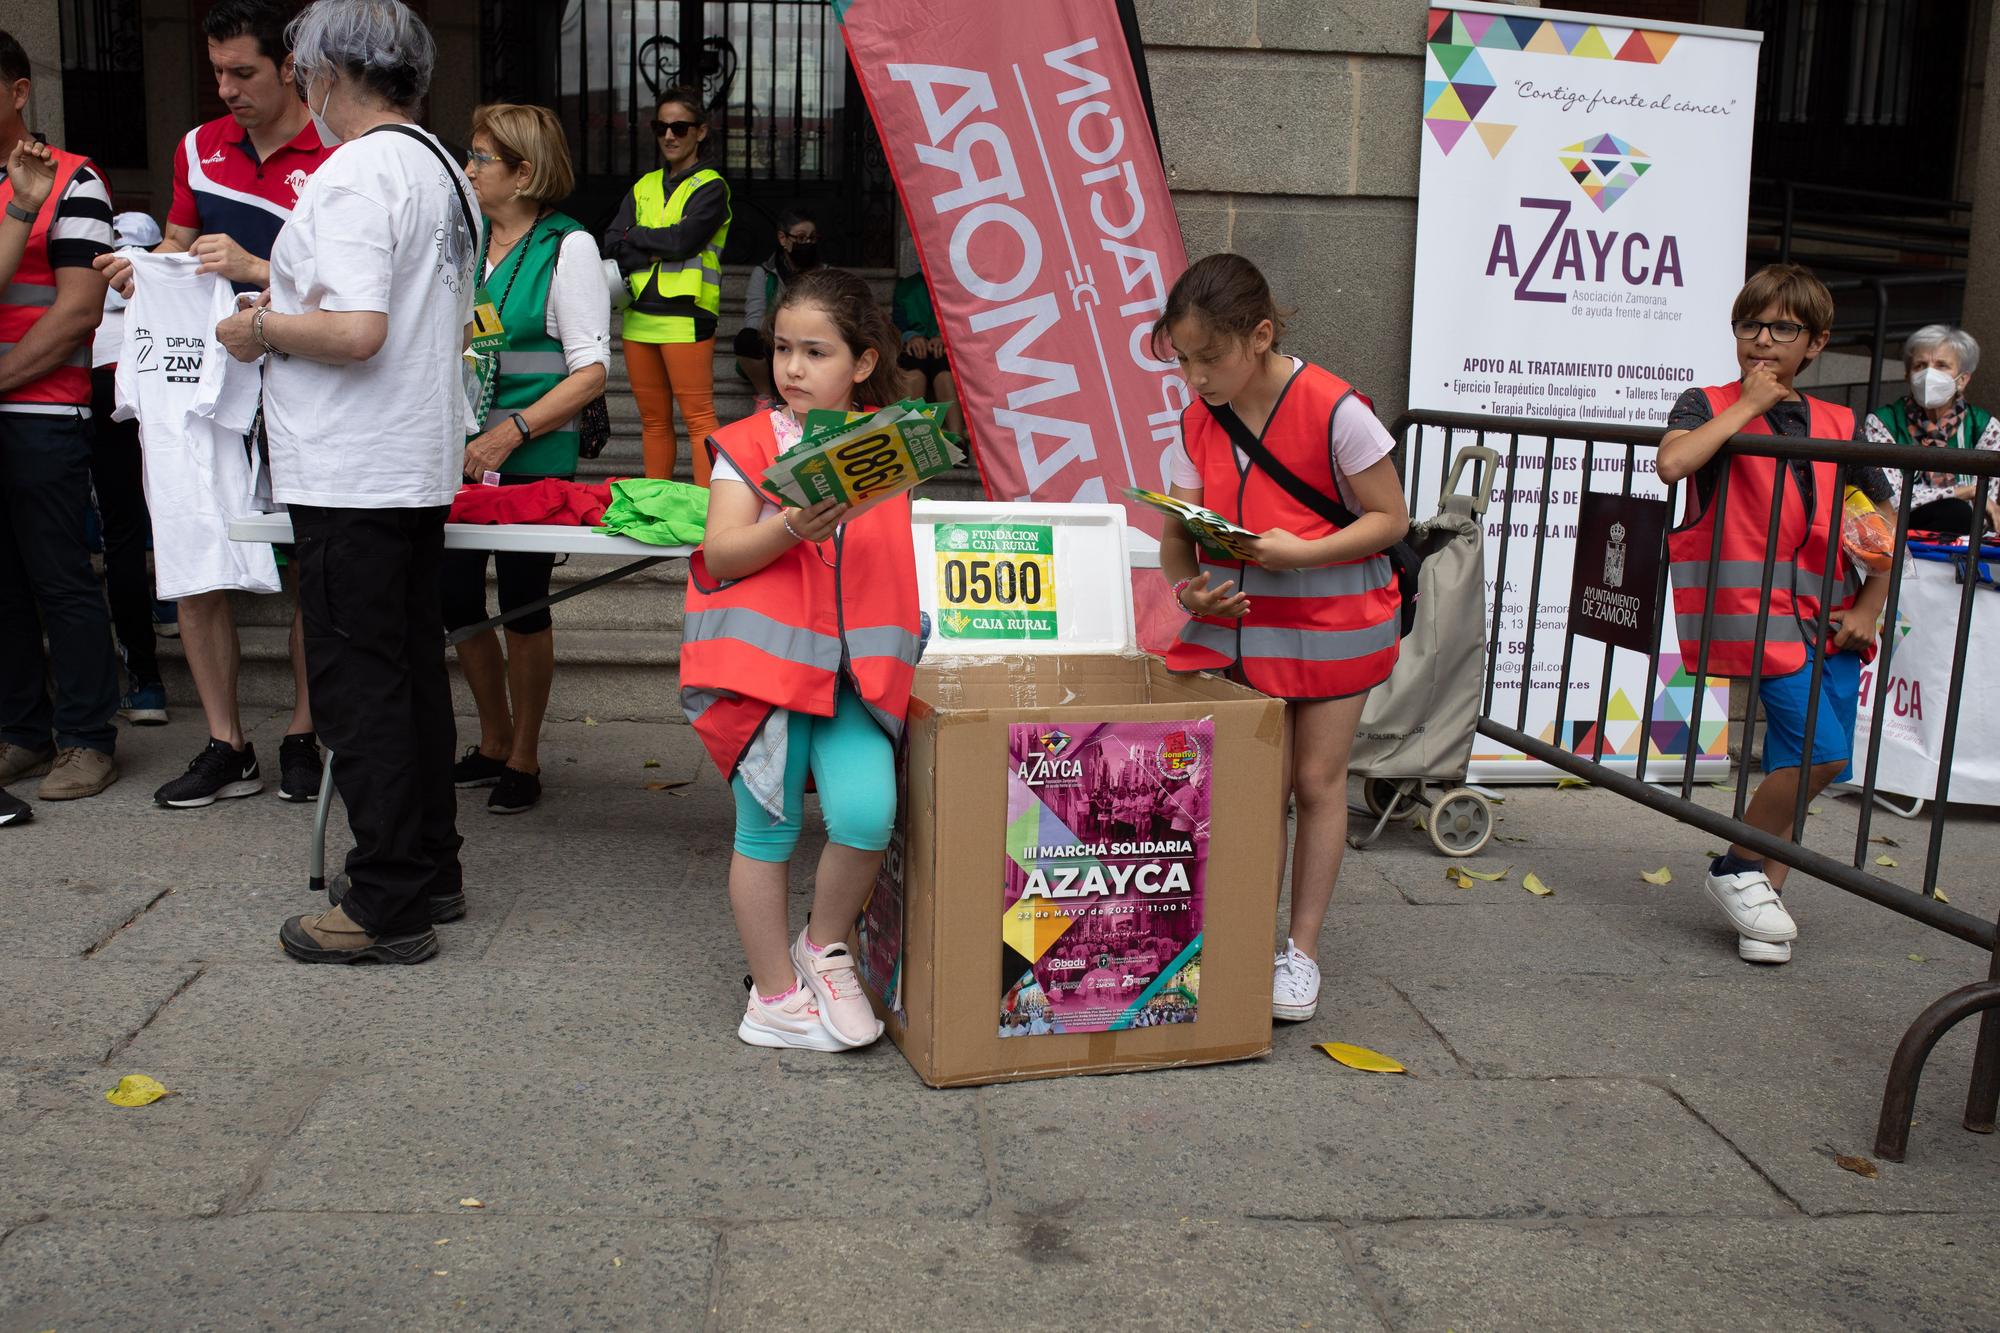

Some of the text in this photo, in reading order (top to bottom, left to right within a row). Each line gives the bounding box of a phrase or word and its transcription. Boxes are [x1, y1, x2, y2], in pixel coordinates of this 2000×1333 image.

[1586, 89, 1648, 113] frente
[1650, 94, 1672, 110] al
[1572, 289, 1667, 306] Asociación Zamorana
[1571, 305, 1682, 321] de ayuda frente al cáncer
[1463, 358, 1694, 382] APOYO AL TRATAMIENTO ONCOLÓGICO
[1453, 379, 1597, 399] Ejercicio Terapéutico Oncológico
[1625, 386, 1658, 401] Talleres
[1491, 401, 1523, 417] Terapia
[1526, 402, 1576, 419] Psicológica
[1579, 405, 1626, 420] (Individual
[1629, 409, 1634, 422] y
[1635, 407, 1646, 420] de
[1563, 490, 1578, 505] DE
[971, 529, 1039, 541] FUNDACION
[972, 540, 1040, 551] CAJA RURAL
[944, 559, 1041, 605] 0500
[1583, 586, 1640, 611] AYUNTAMIENTO
[1511, 619, 1524, 629] 13
[1582, 599, 1638, 629] DE ZAMORA
[972, 618, 1051, 631] CAJA RURAL
[1017, 752, 1083, 786] AZAYCA
[1023, 840, 1192, 860] III MARCHA SOLIDARIA
[1021, 863, 1191, 900] AZAYCA
[1017, 911, 1031, 920] 22
[1055, 908, 1085, 917] MAYO
[1091, 907, 1104, 916] de
[1109, 905, 1135, 914] 2022
[1148, 903, 1177, 912] 11:00
